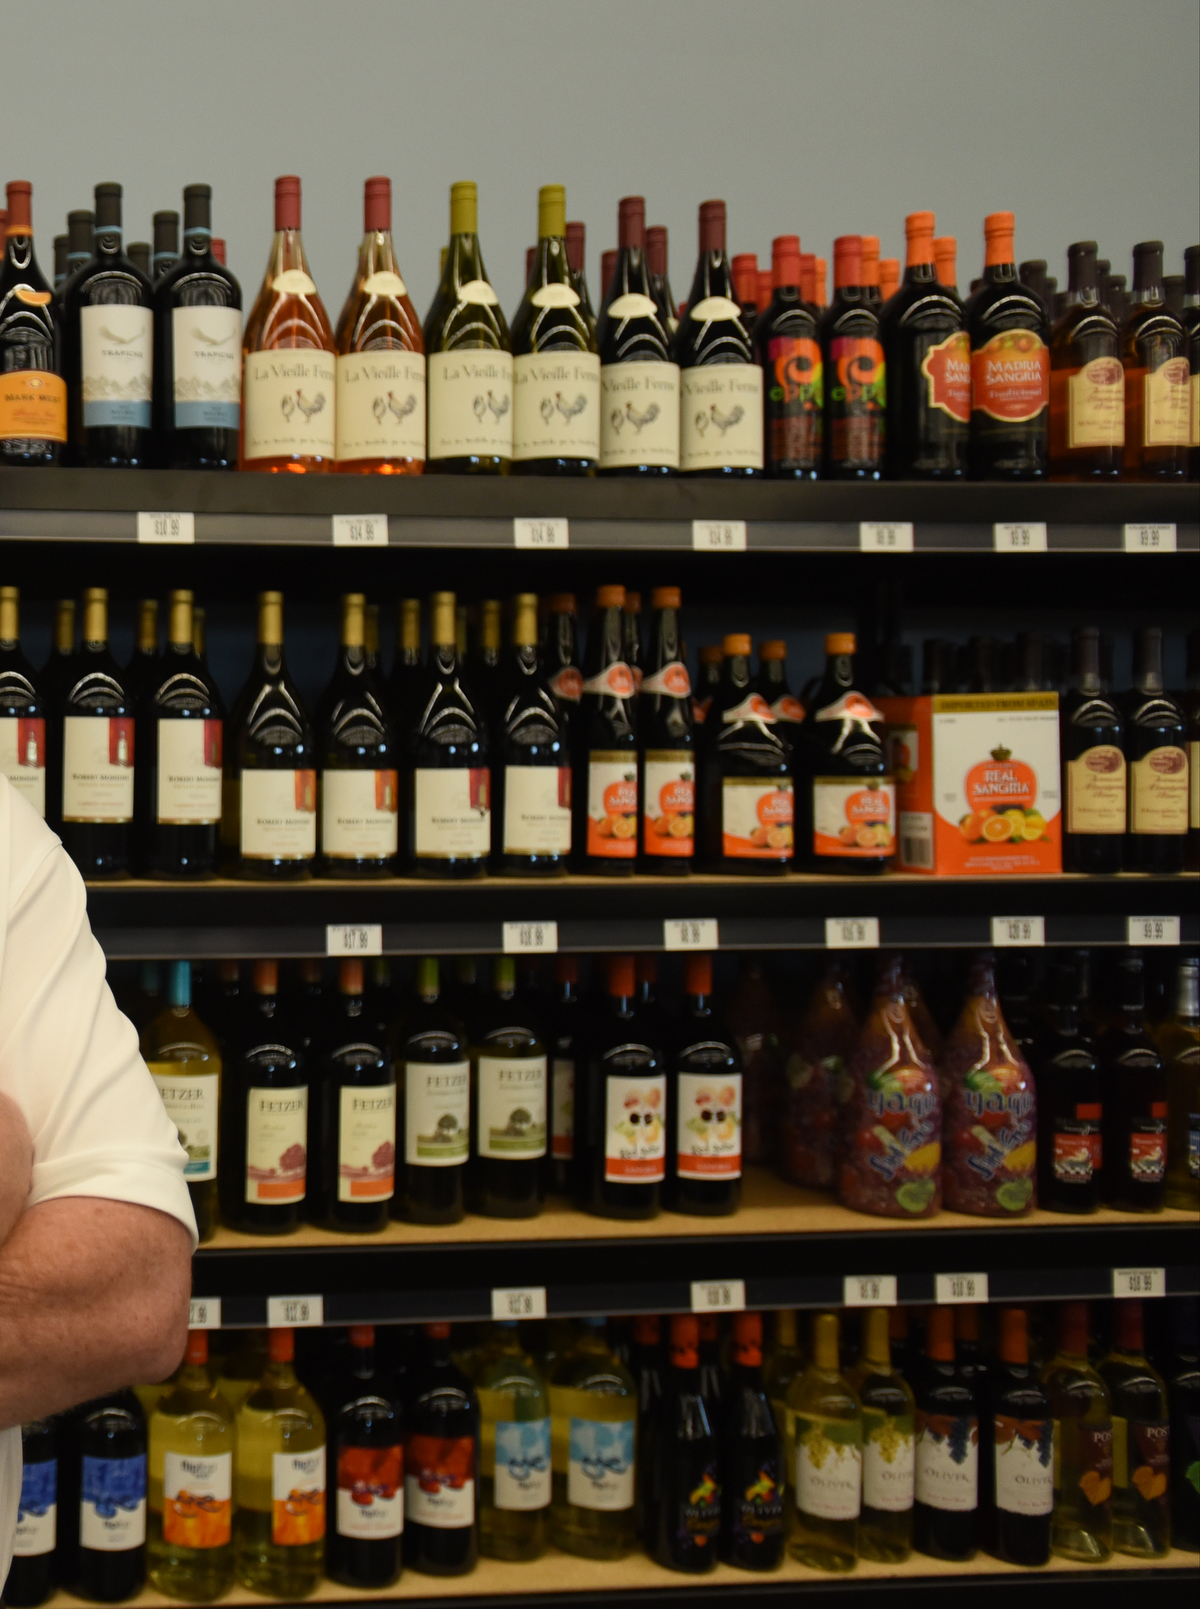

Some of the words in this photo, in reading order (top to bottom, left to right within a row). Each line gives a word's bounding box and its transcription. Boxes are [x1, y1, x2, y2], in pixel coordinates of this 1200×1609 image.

[946, 358, 971, 372] MAD
[987, 360, 1042, 373] MADRIA
[313, 365, 335, 381] Ferm
[404, 366, 425, 382] Ferm
[574, 366, 600, 382] Ferm
[986, 371, 1042, 385] SANGRIA
[644, 378, 675, 391] Ferm
[730, 379, 759, 393] Ferm
[4, 393, 35, 402] MARK
[38, 393, 62, 403] WEST
[72, 773, 99, 781] ROBERT
[985, 769, 1018, 782] REAL
[972, 781, 1030, 795] SANGRIA
[261, 1099, 303, 1112] FETZER
[881, 1471, 912, 1481] OLIVE
[925, 1467, 971, 1483] OLIVER
